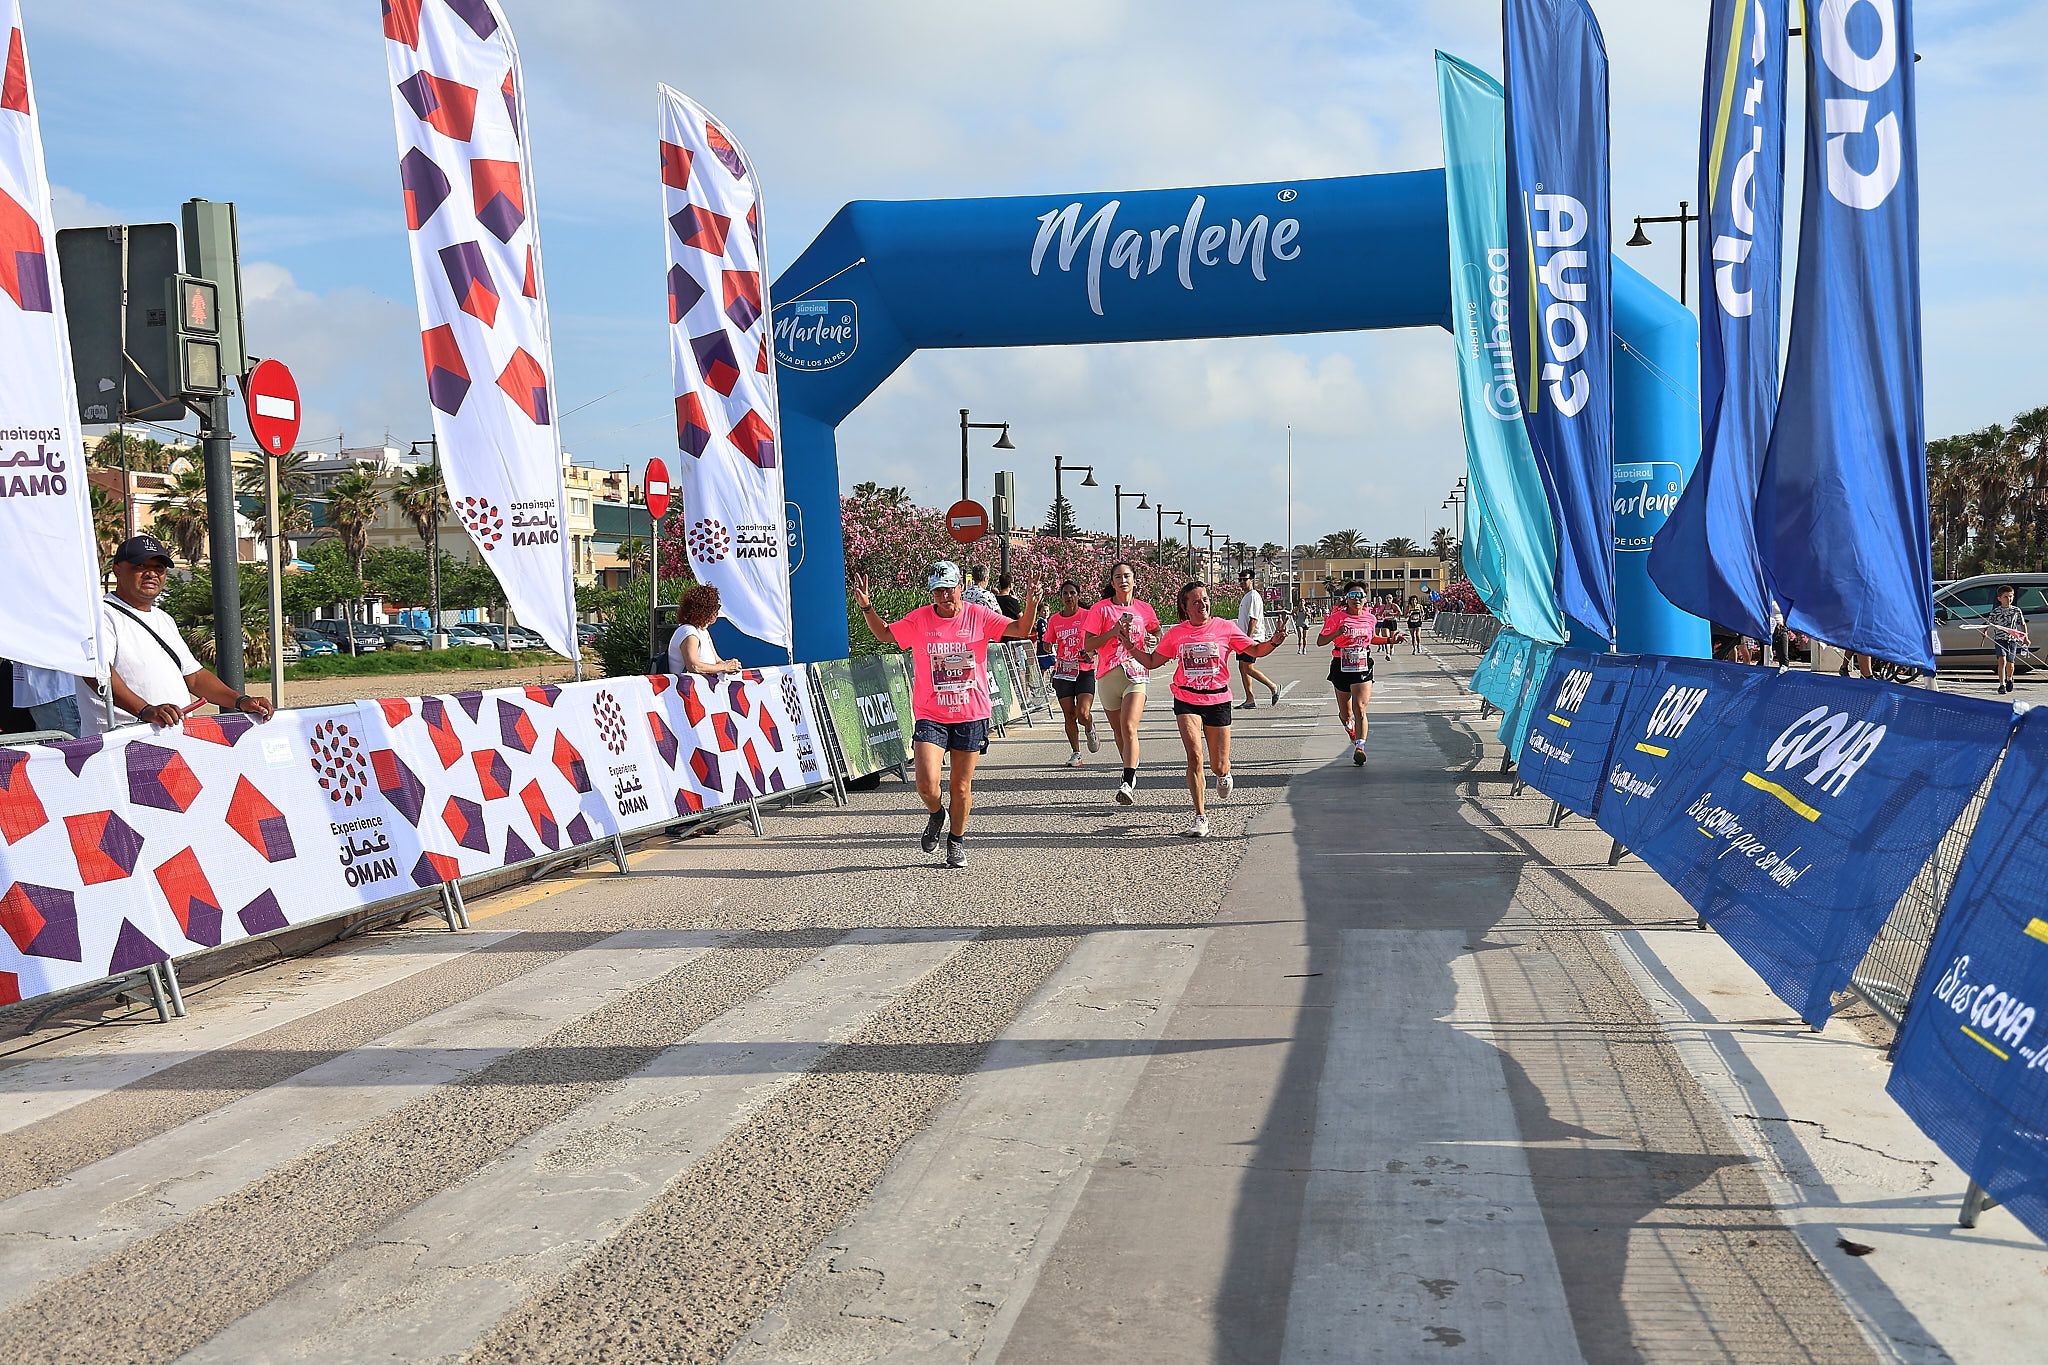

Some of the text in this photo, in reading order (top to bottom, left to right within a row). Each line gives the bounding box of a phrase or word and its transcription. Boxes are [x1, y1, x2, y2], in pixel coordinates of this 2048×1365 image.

[1031, 195, 1301, 316] Marlene
[774, 315, 852, 352] Marlene
[777, 350, 793, 363] HIJA
[795, 358, 804, 366] DE
[824, 350, 846, 365] ALPES
[1613, 481, 1679, 519] arlene
[1628, 537, 1647, 546] LOS
[927, 643, 967, 654] CARRERA
[937, 693, 970, 706] MUJER
[1554, 669, 1593, 714] GOYA
[1645, 685, 1708, 739] GOYA
[1764, 705, 1887, 797] GOYA
[608, 763, 638, 777] Experience
[619, 795, 649, 817] OMAN
[330, 815, 383, 837] Experience
[1718, 834, 1766, 859] que
[344, 857, 399, 888] OMAN
[1951, 984, 1978, 1014] es
